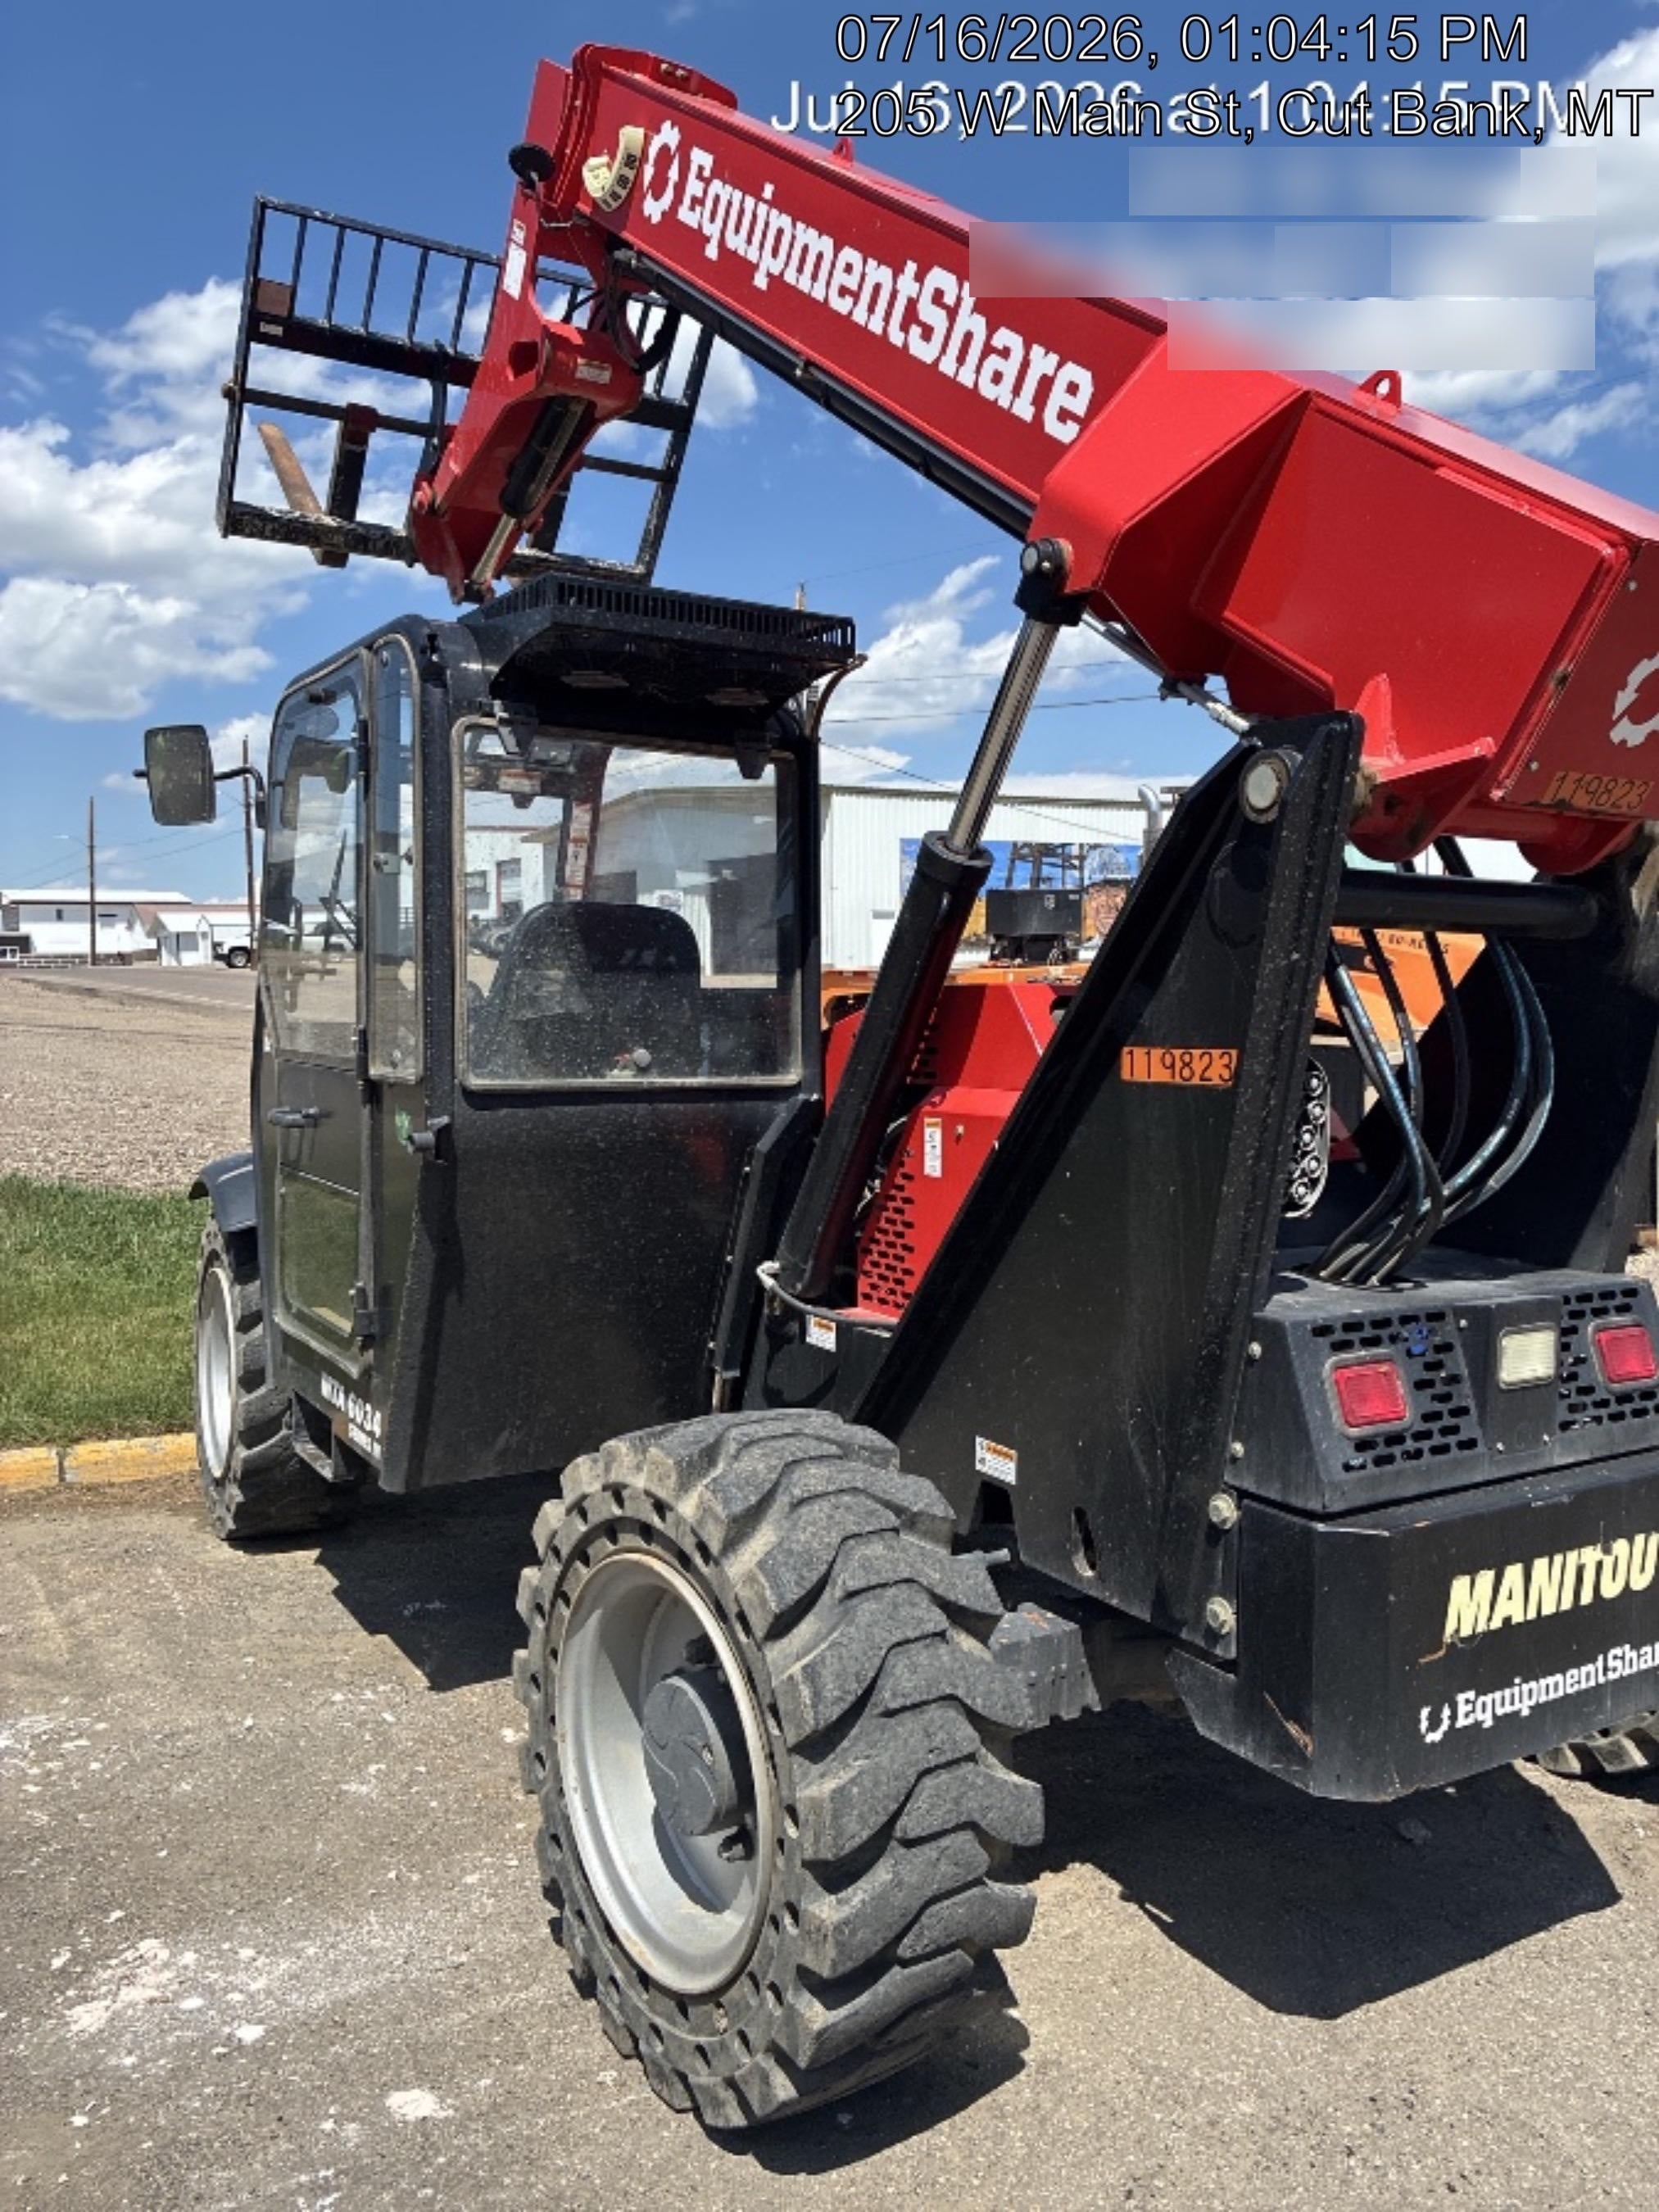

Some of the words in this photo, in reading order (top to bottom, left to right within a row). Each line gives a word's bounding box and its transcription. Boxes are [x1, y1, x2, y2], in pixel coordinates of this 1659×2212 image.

[678, 147, 1095, 444] EquipmentShare
[1551, 771, 1651, 809] 119823
[1125, 1049, 1234, 1083] 119823
[1442, 1530, 1659, 1644] MANITOU
